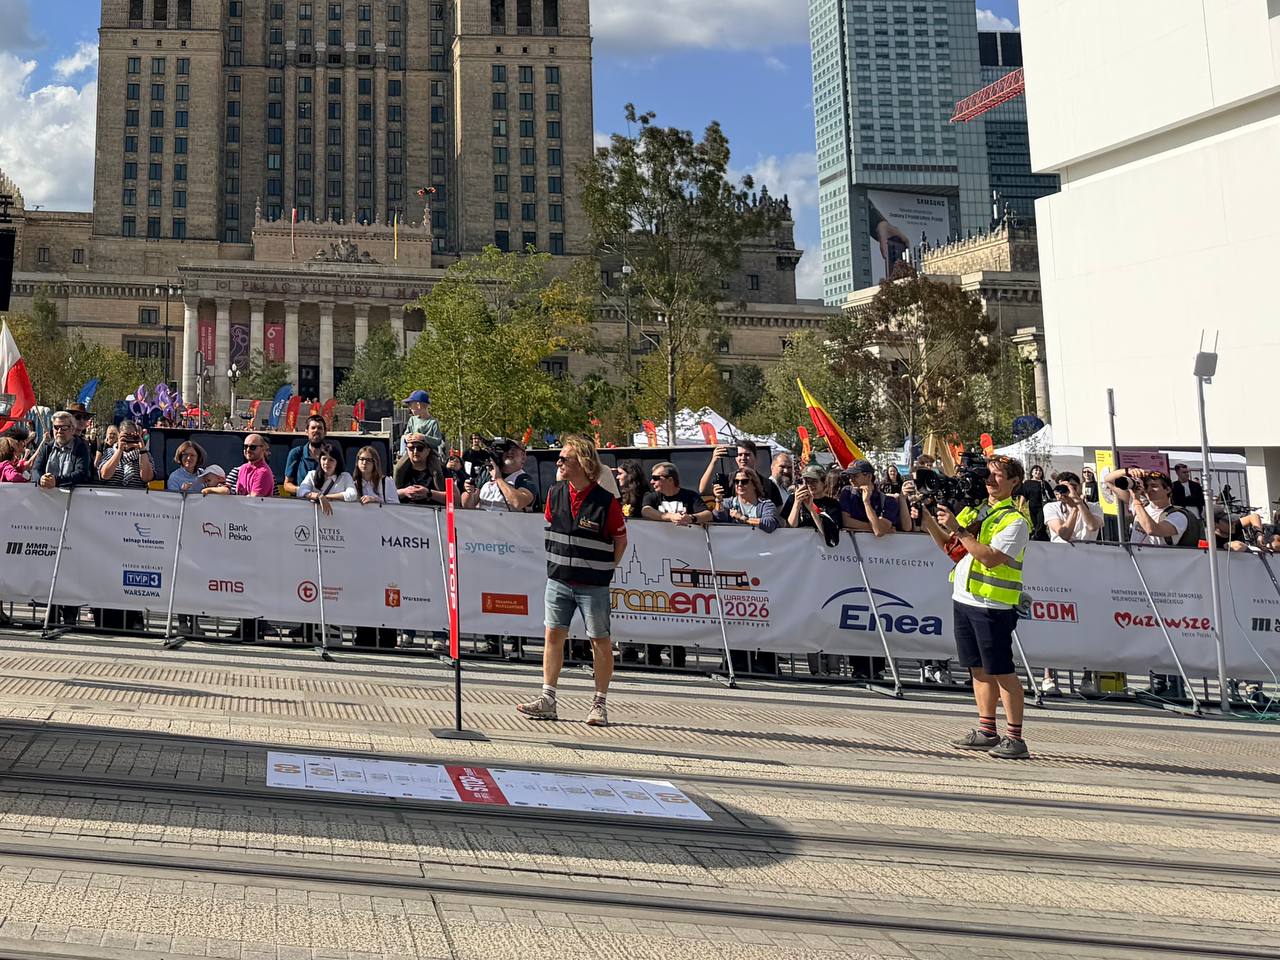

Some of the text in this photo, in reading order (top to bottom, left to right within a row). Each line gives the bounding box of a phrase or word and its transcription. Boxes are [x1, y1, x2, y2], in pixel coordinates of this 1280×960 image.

[916, 198, 945, 207] SAMSUNG
[301, 283, 372, 296] KULTURY
[229, 523, 248, 532] Bank
[229, 532, 252, 541] Pekao
[381, 535, 430, 549] MARSH
[25, 542, 49, 550] MMR
[465, 541, 516, 555] synergic
[24, 549, 57, 557] GROUP
[820, 553, 935, 568] SPONSO STRATEGICZNY
[208, 579, 245, 593] ams
[123, 589, 161, 598] WARSZAWA
[723, 594, 770, 603] WARSZAWA
[609, 588, 723, 615] ramem
[725, 602, 770, 619] 2026
[839, 604, 943, 636] Enea
